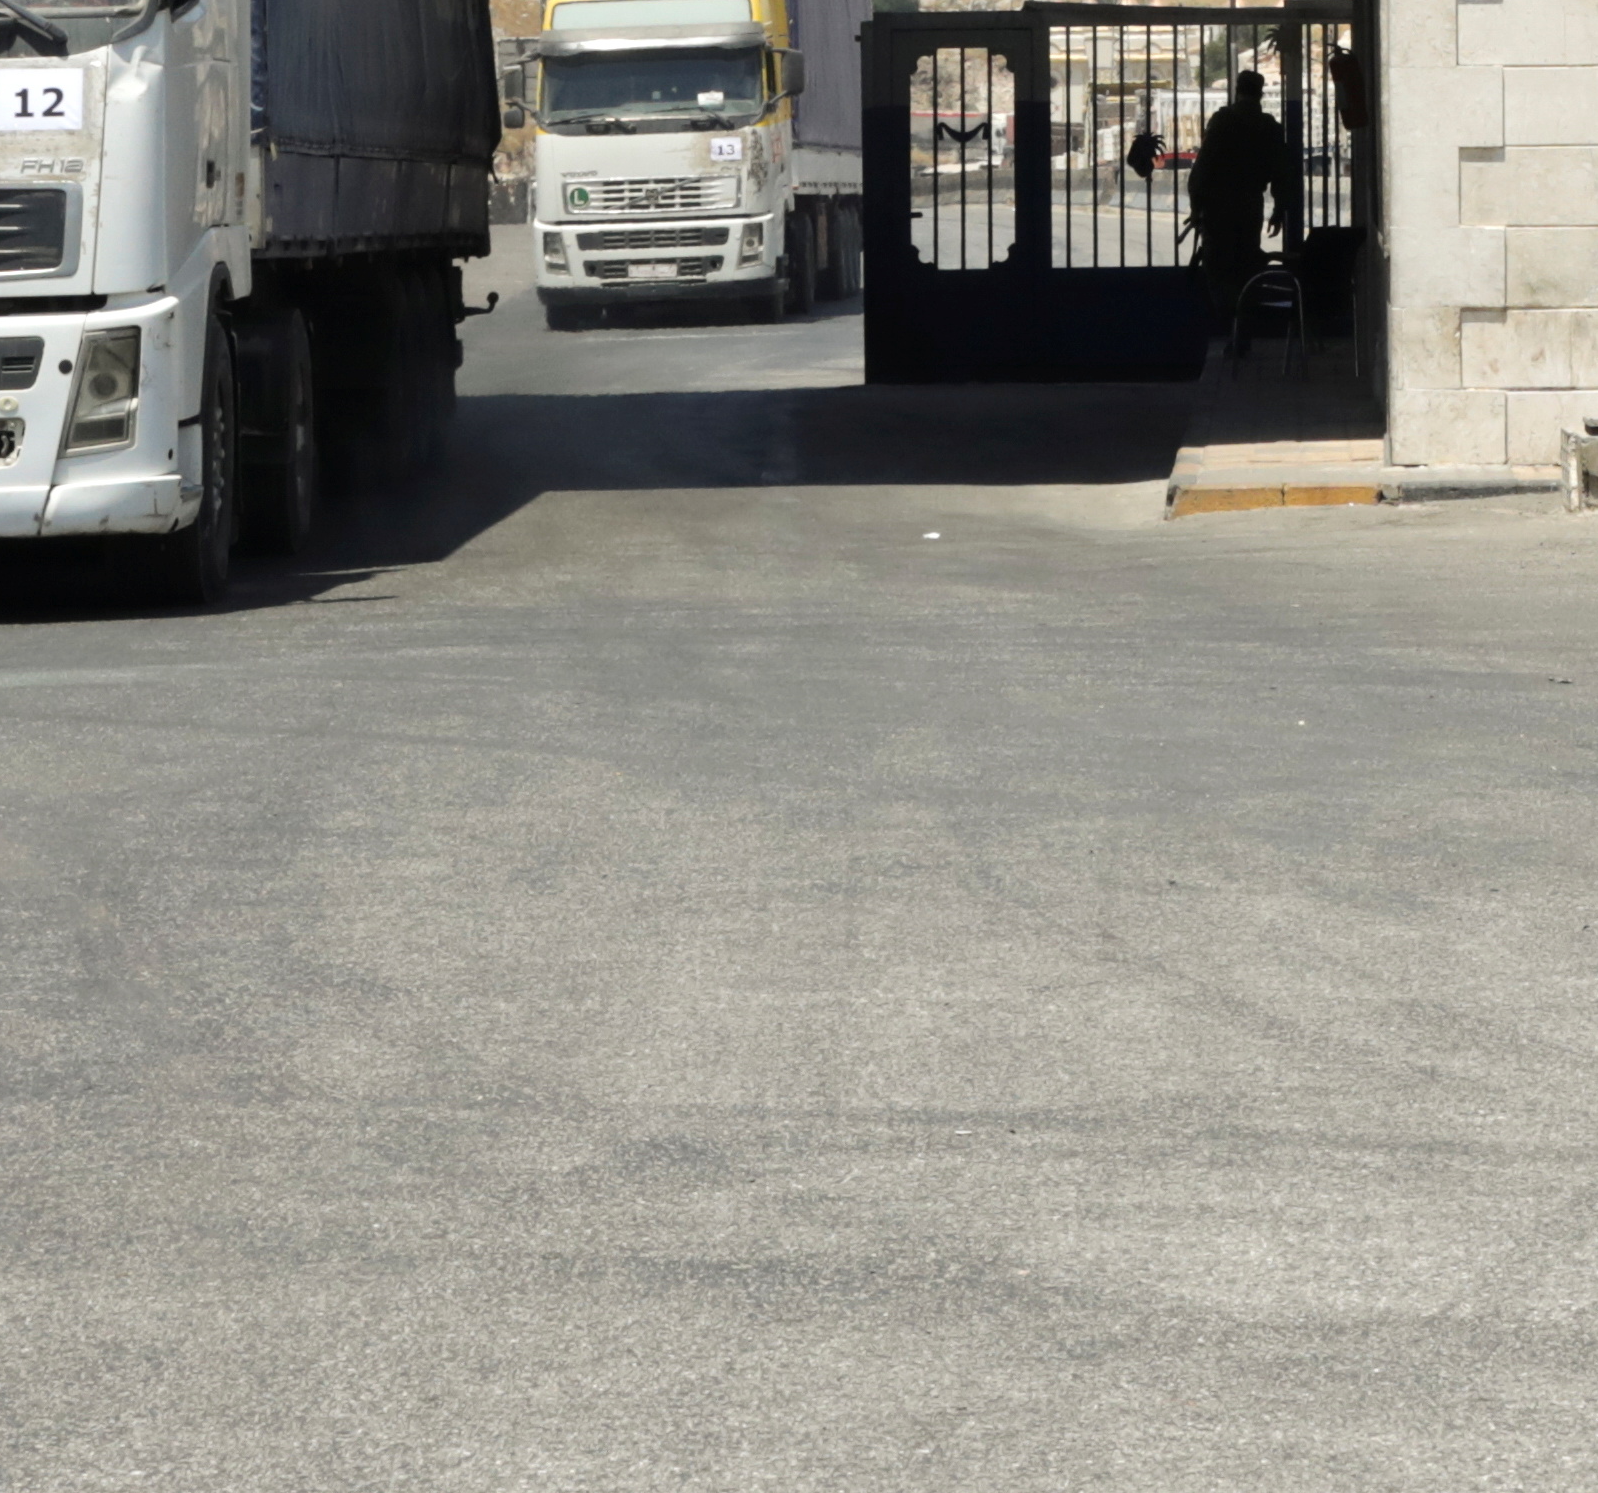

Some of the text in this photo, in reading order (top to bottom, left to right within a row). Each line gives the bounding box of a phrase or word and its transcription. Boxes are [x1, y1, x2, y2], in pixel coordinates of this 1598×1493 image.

[14, 86, 65, 118] 12
[717, 144, 735, 156] 13
[573, 191, 584, 205] L
